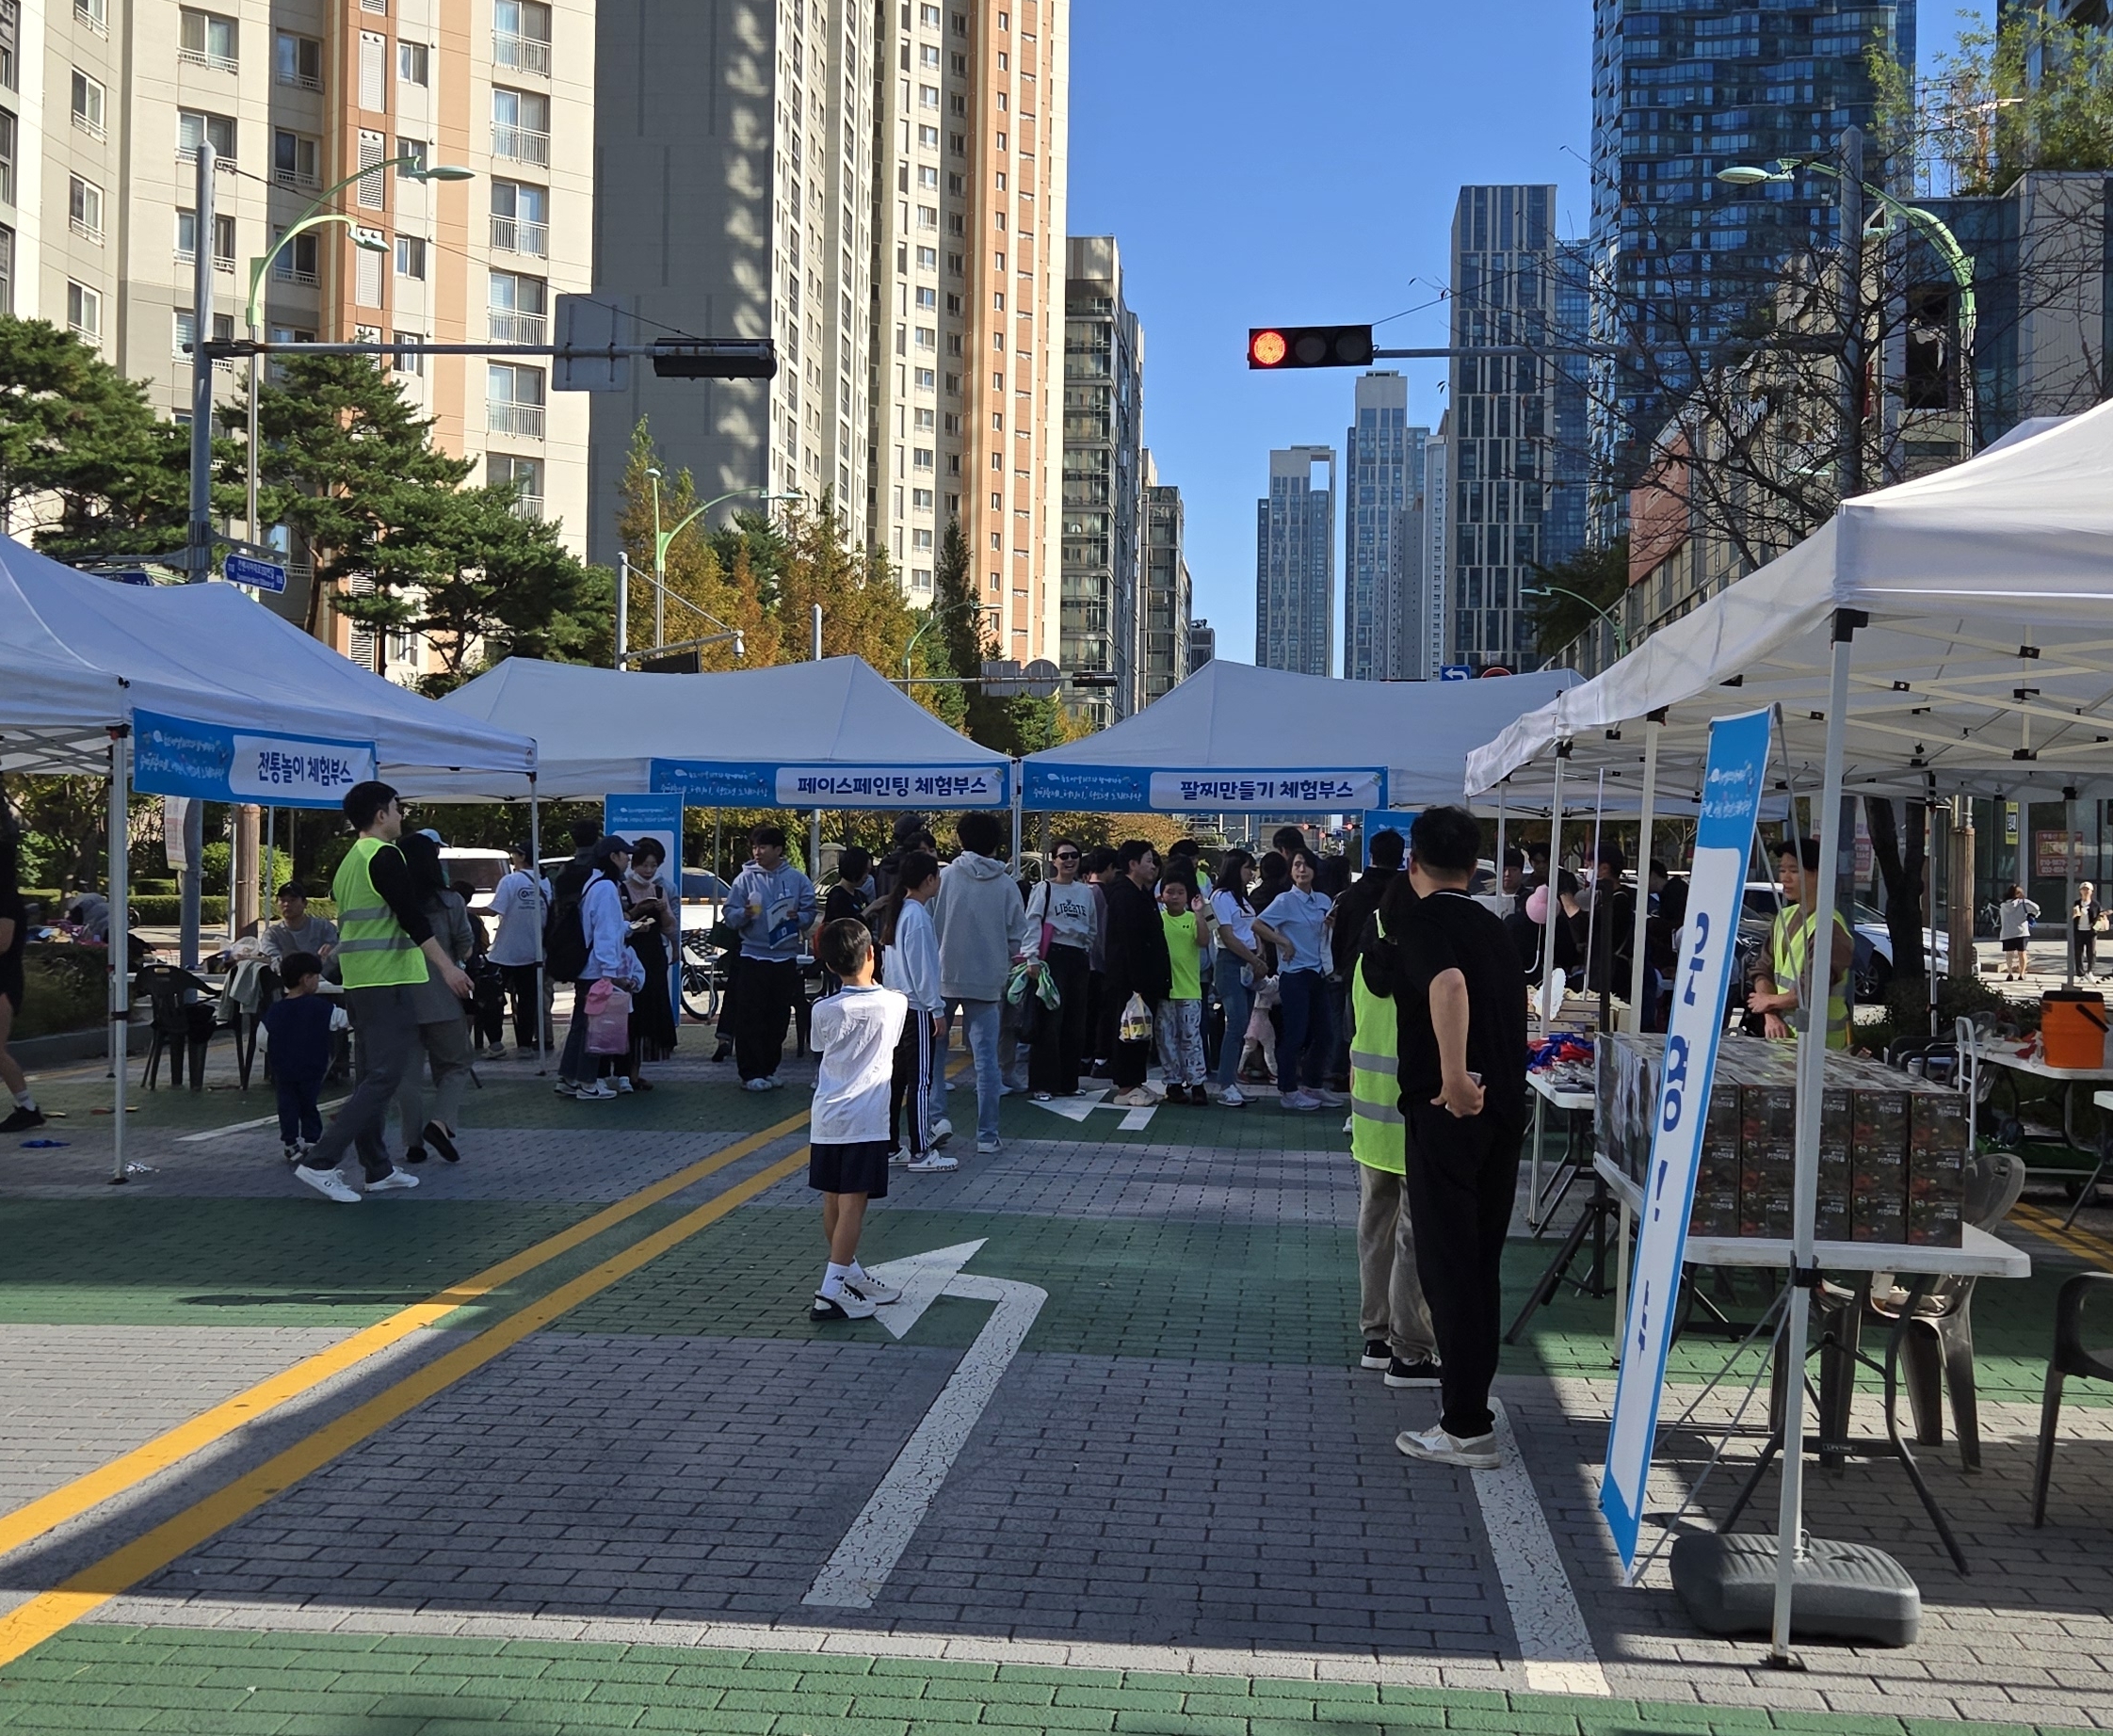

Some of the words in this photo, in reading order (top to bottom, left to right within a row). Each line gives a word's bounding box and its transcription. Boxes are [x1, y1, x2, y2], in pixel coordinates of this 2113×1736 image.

[257, 751, 304, 783] 전통놀이
[307, 755, 354, 786] 체험부스
[798, 776, 910, 797] 페이스페인팅
[914, 776, 988, 796] 체험부스
[1180, 780, 1275, 801] 팔찌만들기
[1280, 780, 1354, 801] 체험부스
